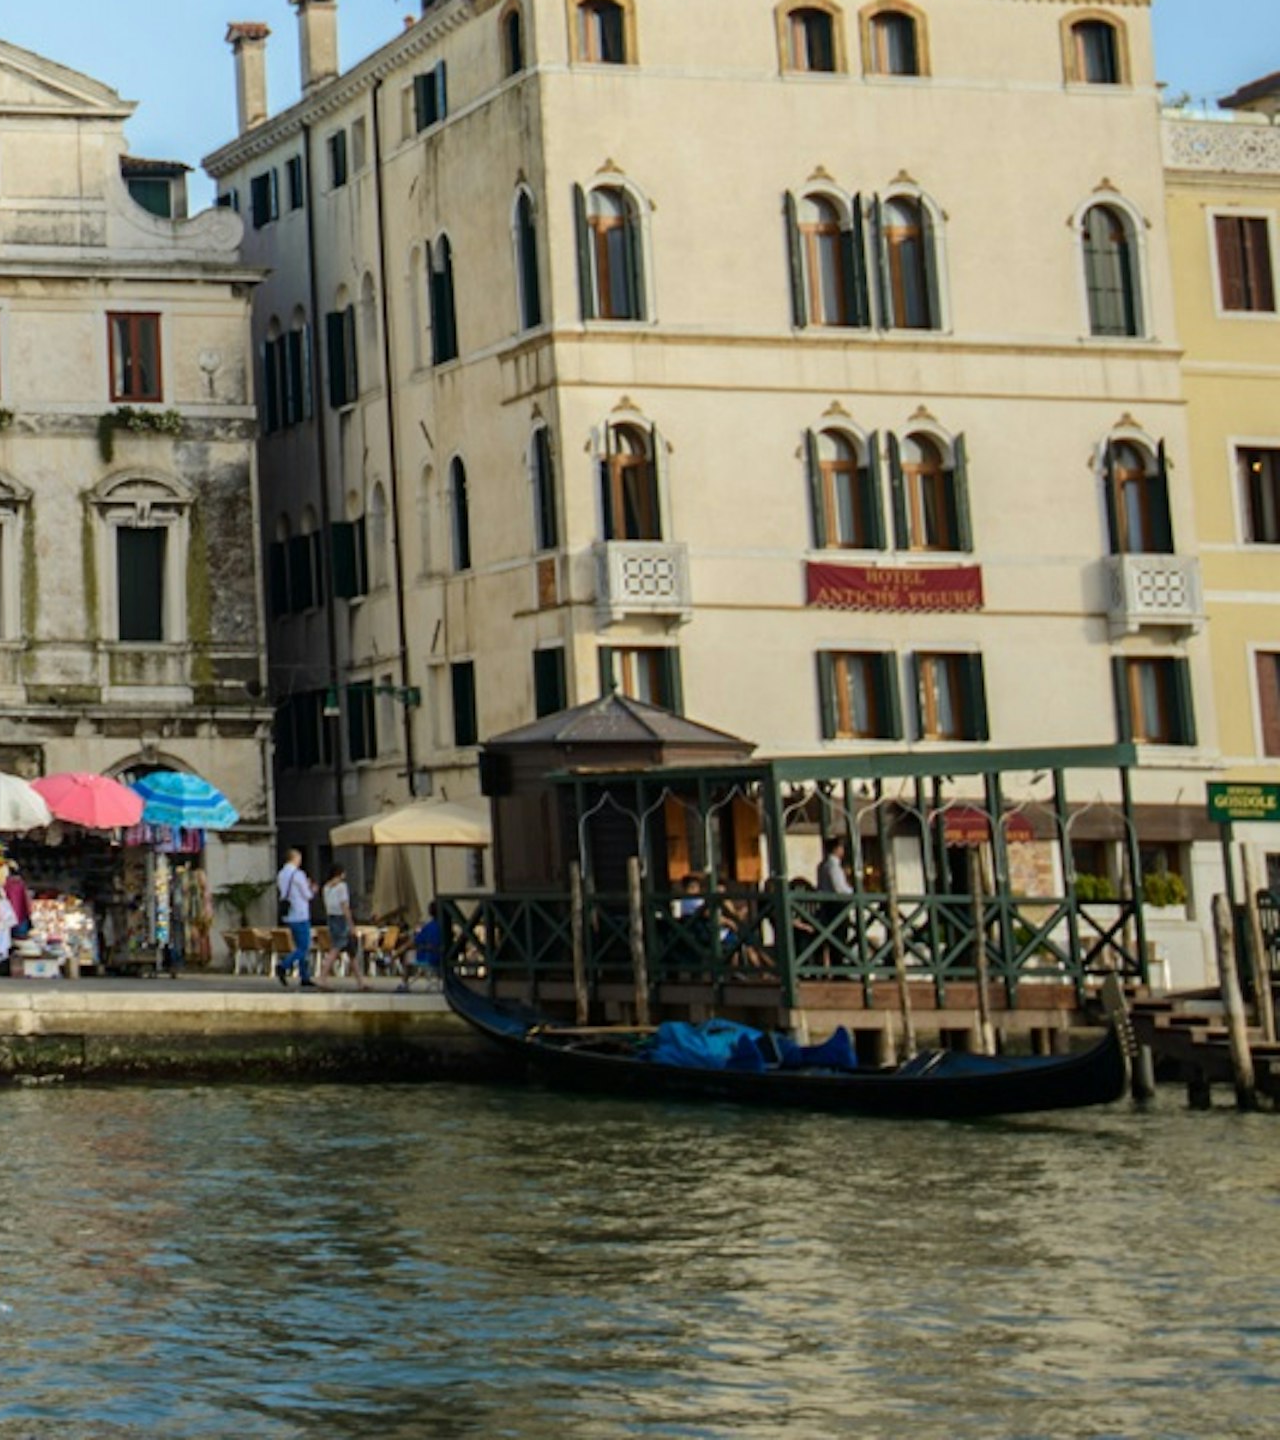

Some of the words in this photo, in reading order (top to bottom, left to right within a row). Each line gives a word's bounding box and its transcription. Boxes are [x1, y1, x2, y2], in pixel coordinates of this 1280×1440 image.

[866, 570, 925, 584] HOTEL
[817, 588, 898, 604] ANTICHE
[909, 590, 975, 605] FIGURE
[1215, 795, 1276, 808] GONDOLE
